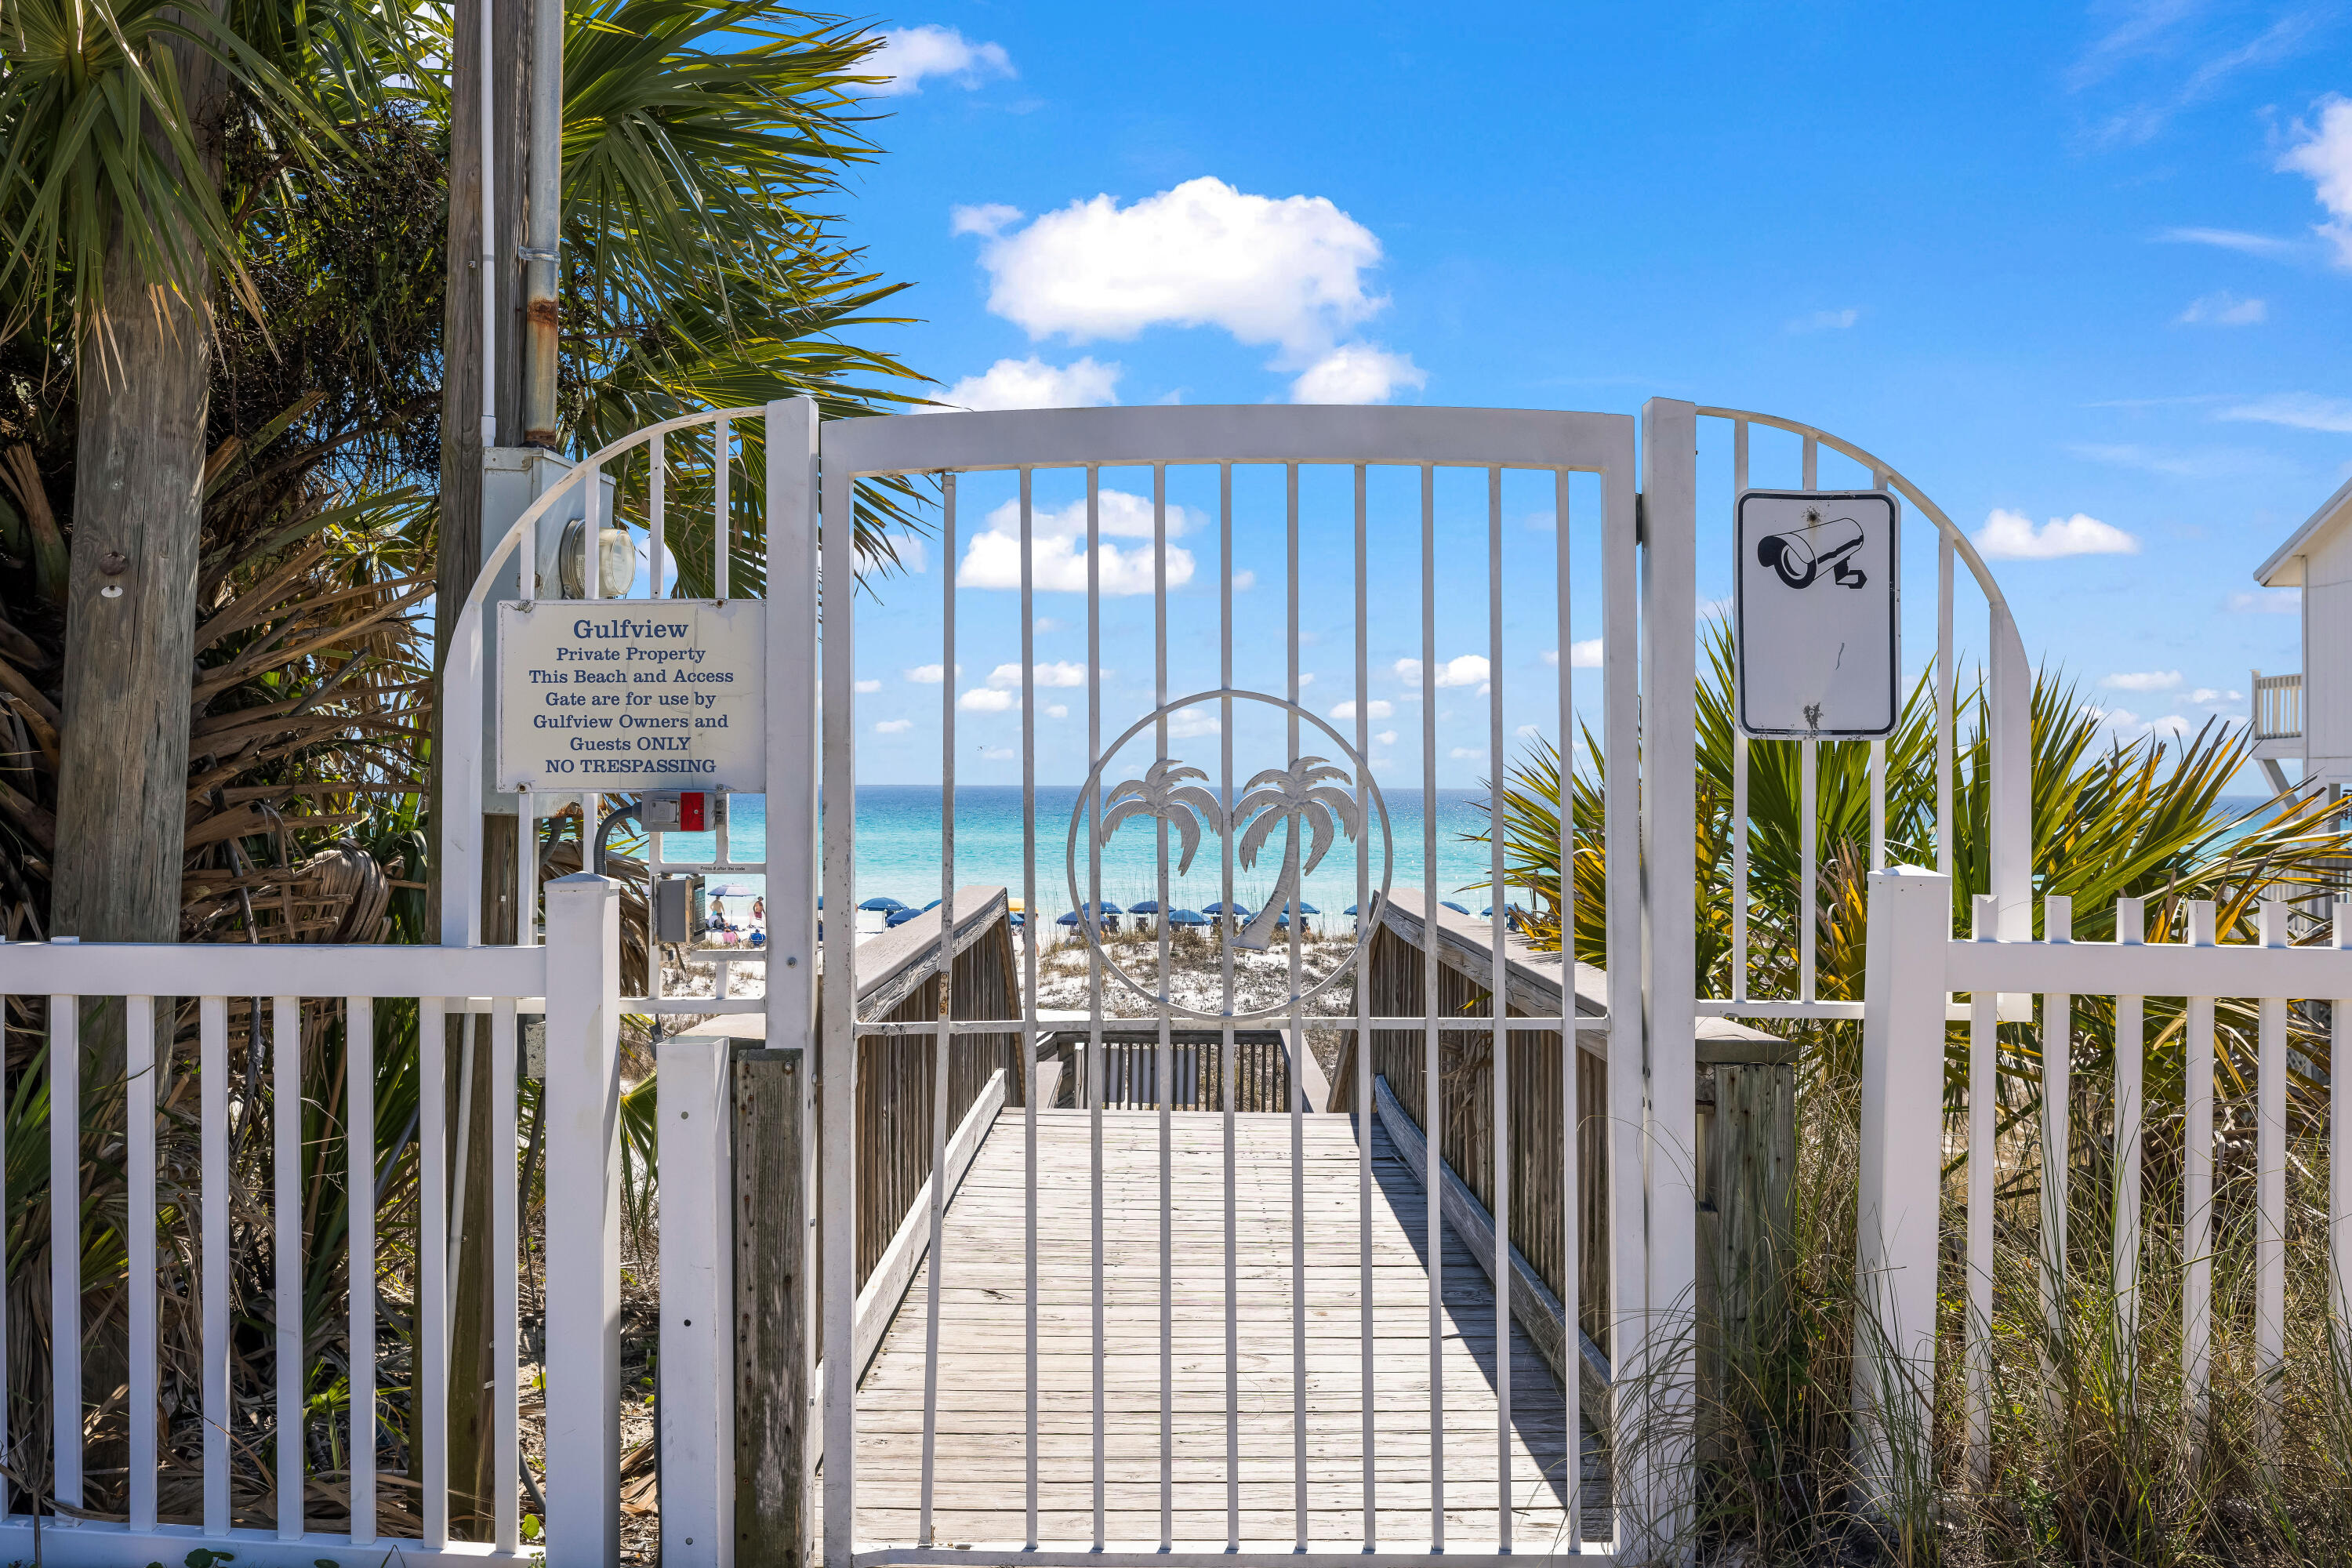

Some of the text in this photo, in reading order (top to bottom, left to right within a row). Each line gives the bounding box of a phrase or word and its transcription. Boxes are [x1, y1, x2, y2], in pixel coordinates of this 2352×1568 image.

[574, 619, 688, 638] Gulfview
[557, 647, 706, 663] Private Property
[529, 670, 733, 683] This Beach and Access
[546, 691, 716, 708] Gate are for use by
[534, 715, 728, 728] Gulfview Owners and
[570, 737, 691, 750] Guests ONLY
[546, 760, 716, 773] NO TRESPASSING
